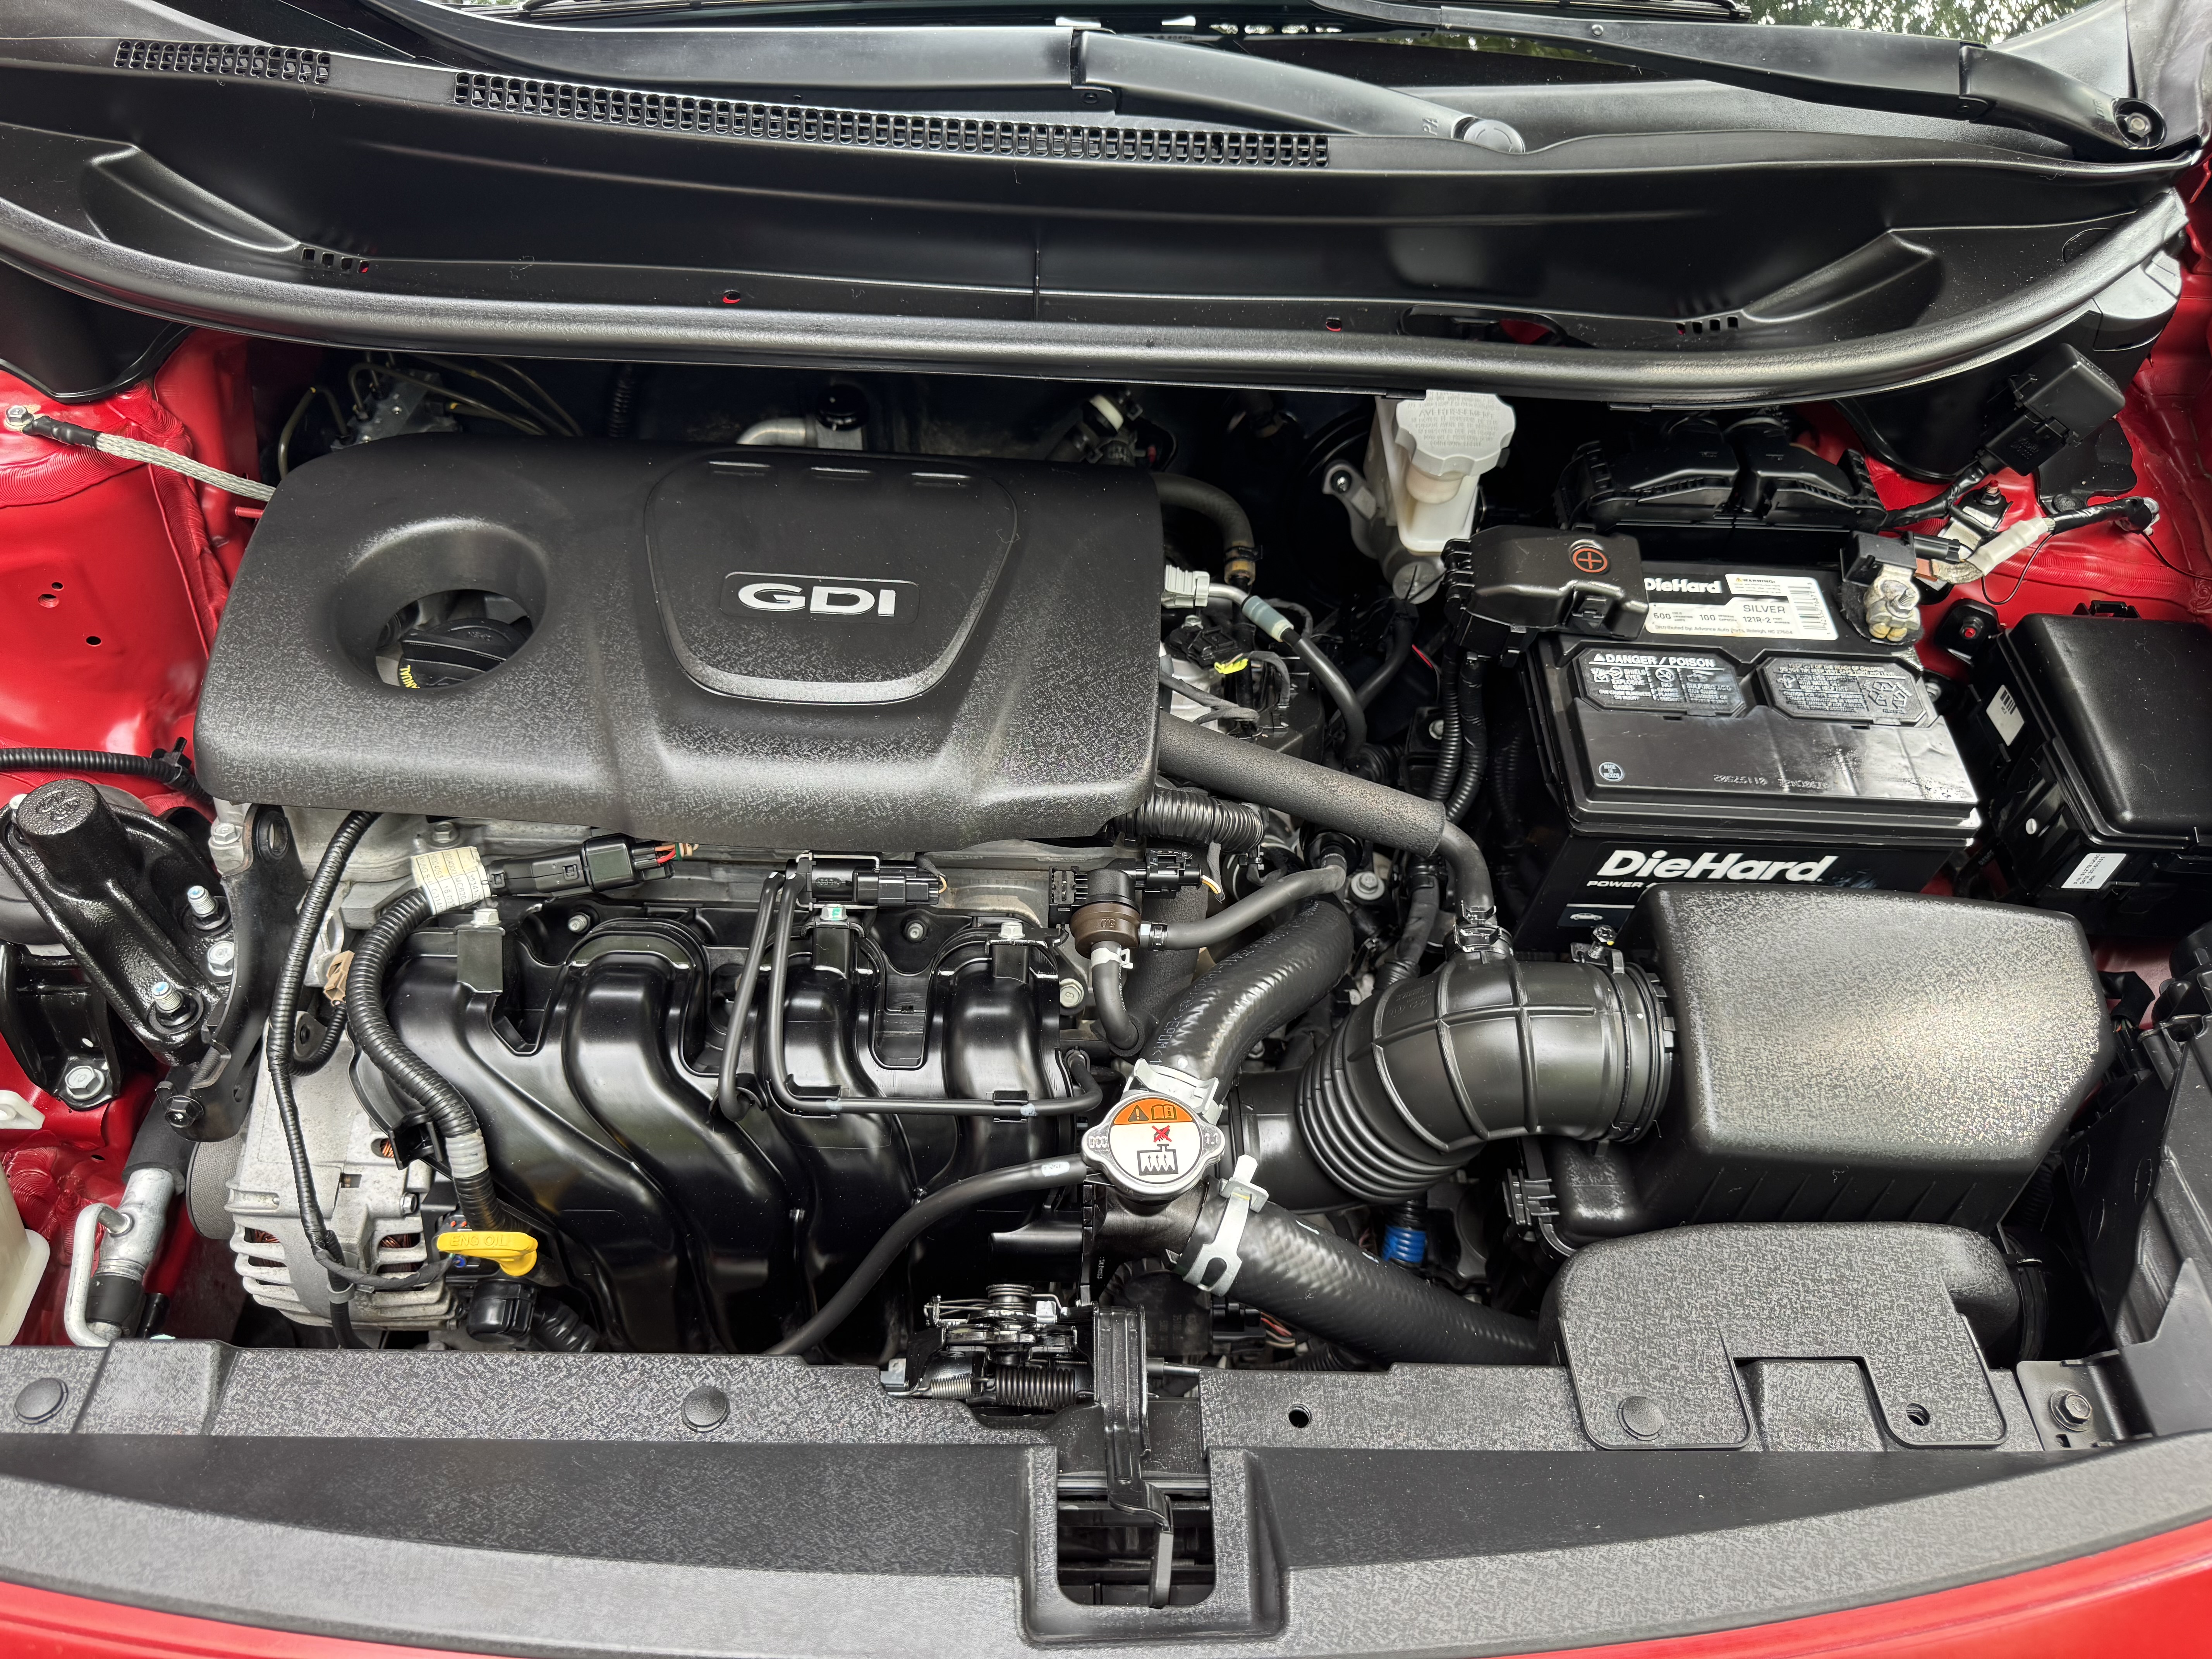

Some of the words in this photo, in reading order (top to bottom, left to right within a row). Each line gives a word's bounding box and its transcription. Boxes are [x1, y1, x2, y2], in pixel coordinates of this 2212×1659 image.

[1422, 117, 1439, 136] PA
[1644, 578, 1722, 594] DieHard
[738, 583, 896, 617] GDI
[1743, 604, 1785, 613] SILVER
[1605, 654, 1657, 665] DANGER
[1659, 657, 1668, 665] /
[1669, 657, 1716, 668] POISON
[1597, 850, 1839, 882] DieHard
[1586, 880, 1644, 888] POWER
[1100, 918, 1116, 928] 5.0
[1089, 1135, 1108, 1149] DCC
[450, 1234, 479, 1247] ENG
[484, 1234, 508, 1247] OIL
